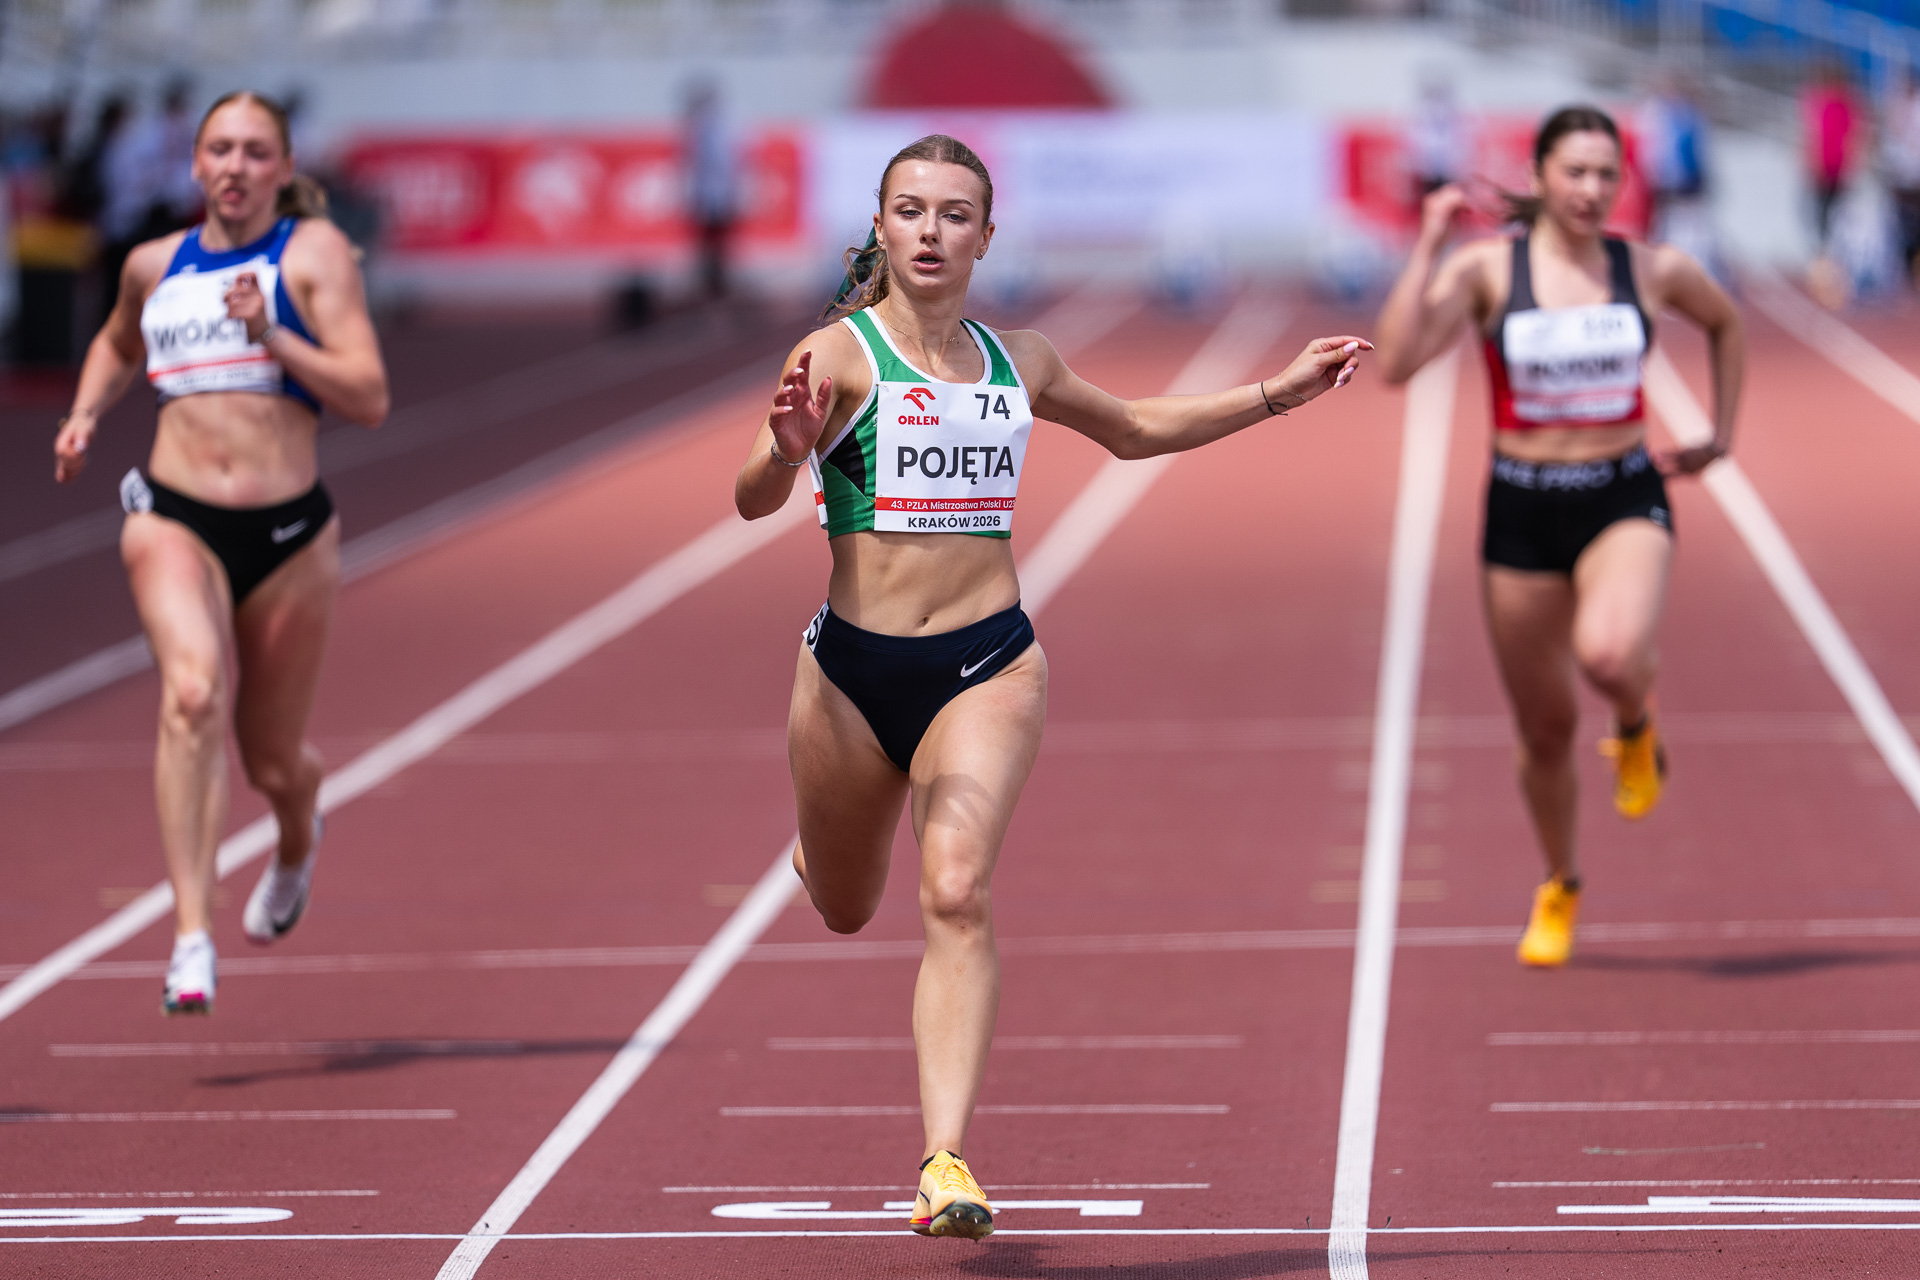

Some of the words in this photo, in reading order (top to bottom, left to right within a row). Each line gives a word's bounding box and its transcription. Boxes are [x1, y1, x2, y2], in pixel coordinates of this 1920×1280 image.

[153, 316, 247, 348] WÓJCI
[974, 393, 1011, 420] 74
[897, 415, 940, 426] ORLEN
[897, 446, 1015, 485] POJĘTA
[890, 500, 905, 510] 43.
[906, 501, 929, 510] PZLA
[930, 500, 979, 510] Mistrzostwa
[979, 499, 1001, 509] Polski
[907, 514, 971, 528] KRAKÓW
[972, 515, 1001, 528] 2026
